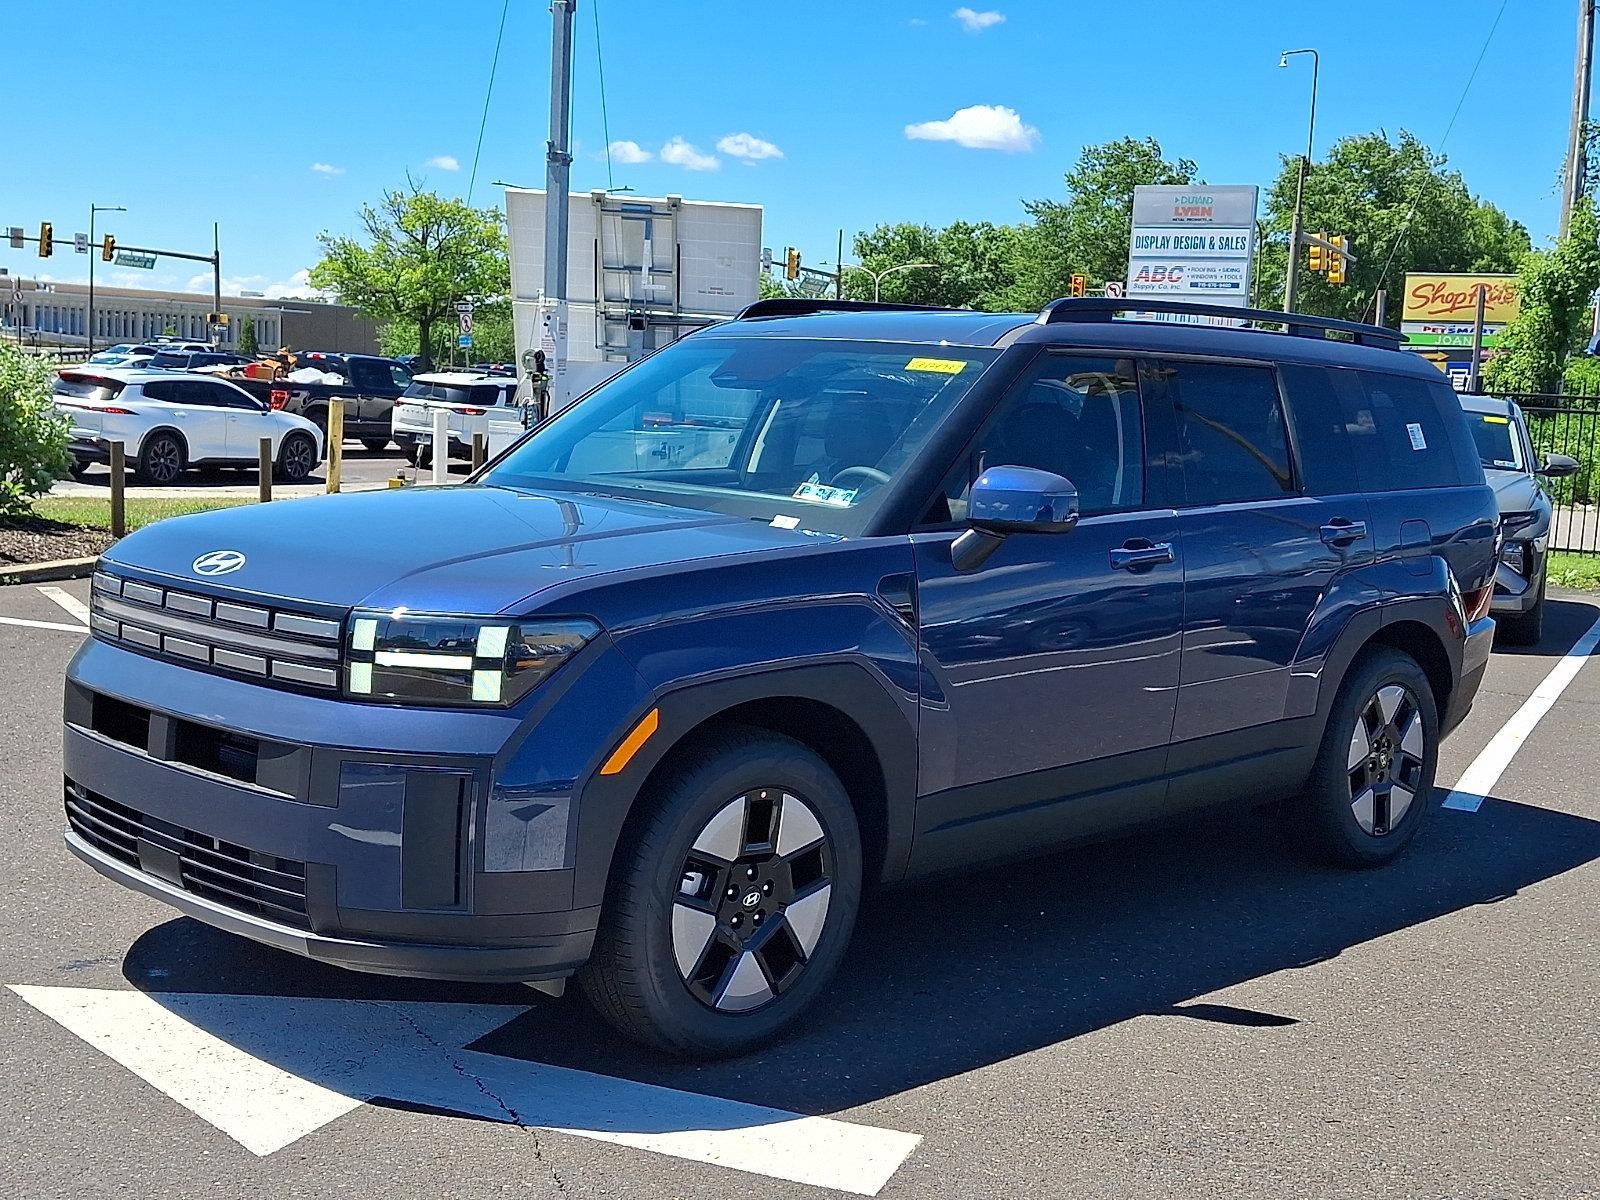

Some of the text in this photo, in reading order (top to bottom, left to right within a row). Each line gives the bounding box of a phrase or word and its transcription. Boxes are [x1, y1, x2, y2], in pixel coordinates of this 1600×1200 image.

[1135, 235, 1247, 250] DISPLAY DESIGN & SALES
[1134, 265, 1187, 283] ABC
[1133, 283, 1157, 291] Supply
